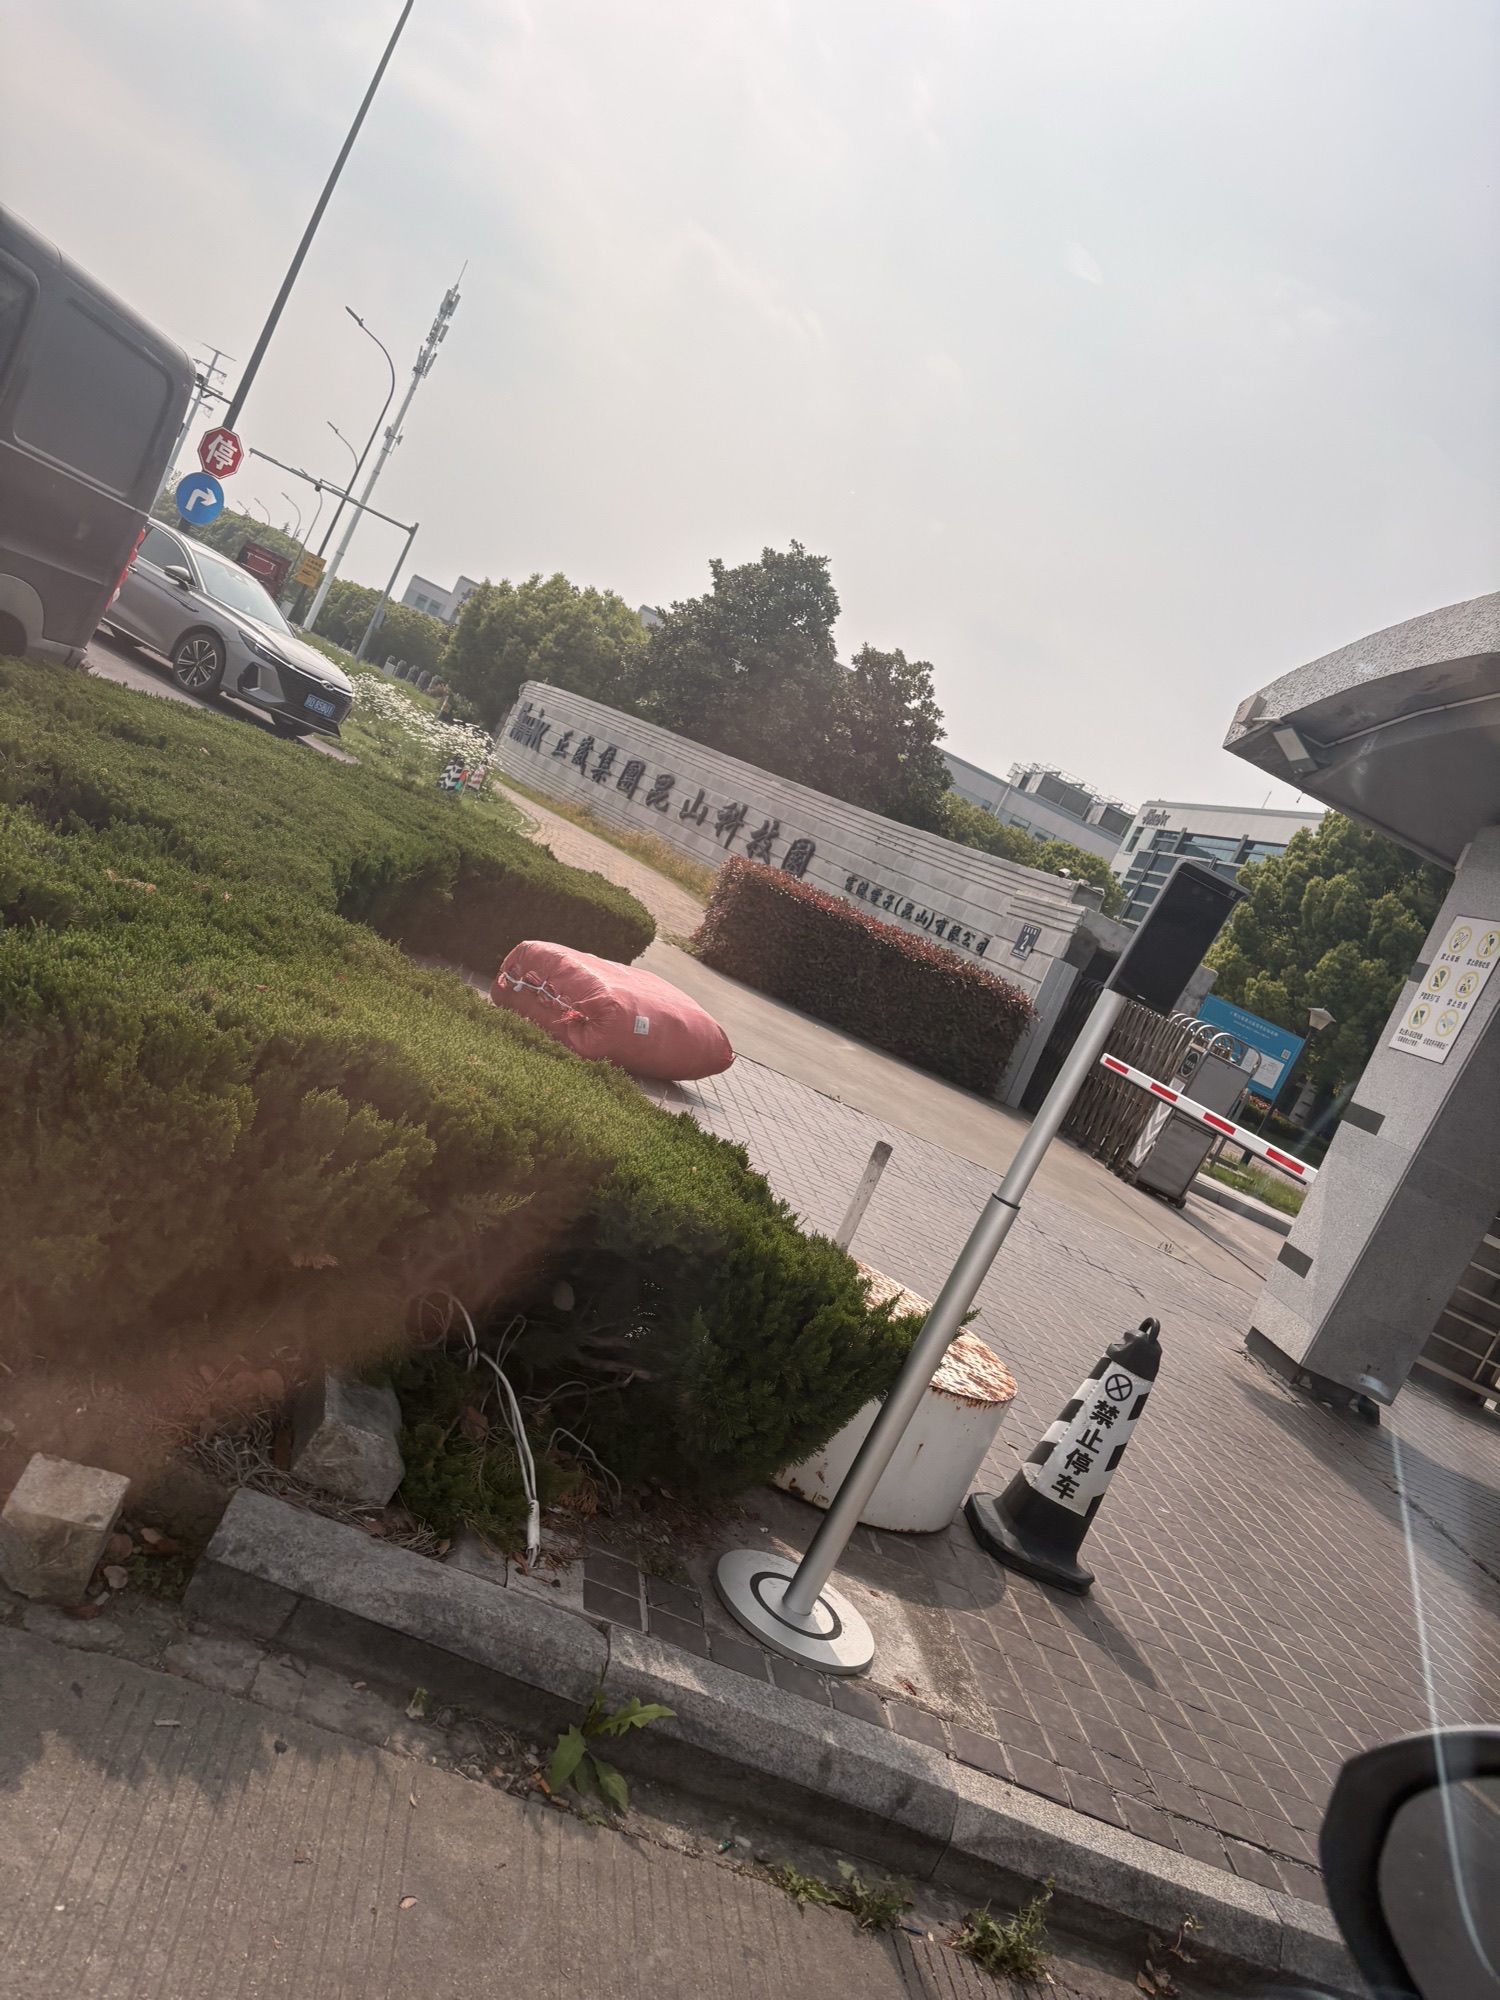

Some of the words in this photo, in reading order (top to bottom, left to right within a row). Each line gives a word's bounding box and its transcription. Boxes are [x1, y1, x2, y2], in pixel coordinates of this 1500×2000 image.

[206, 434, 238, 471] 停
[1020, 934, 1029, 950] 2
[1051, 1399, 1120, 1500] 禁止停车
